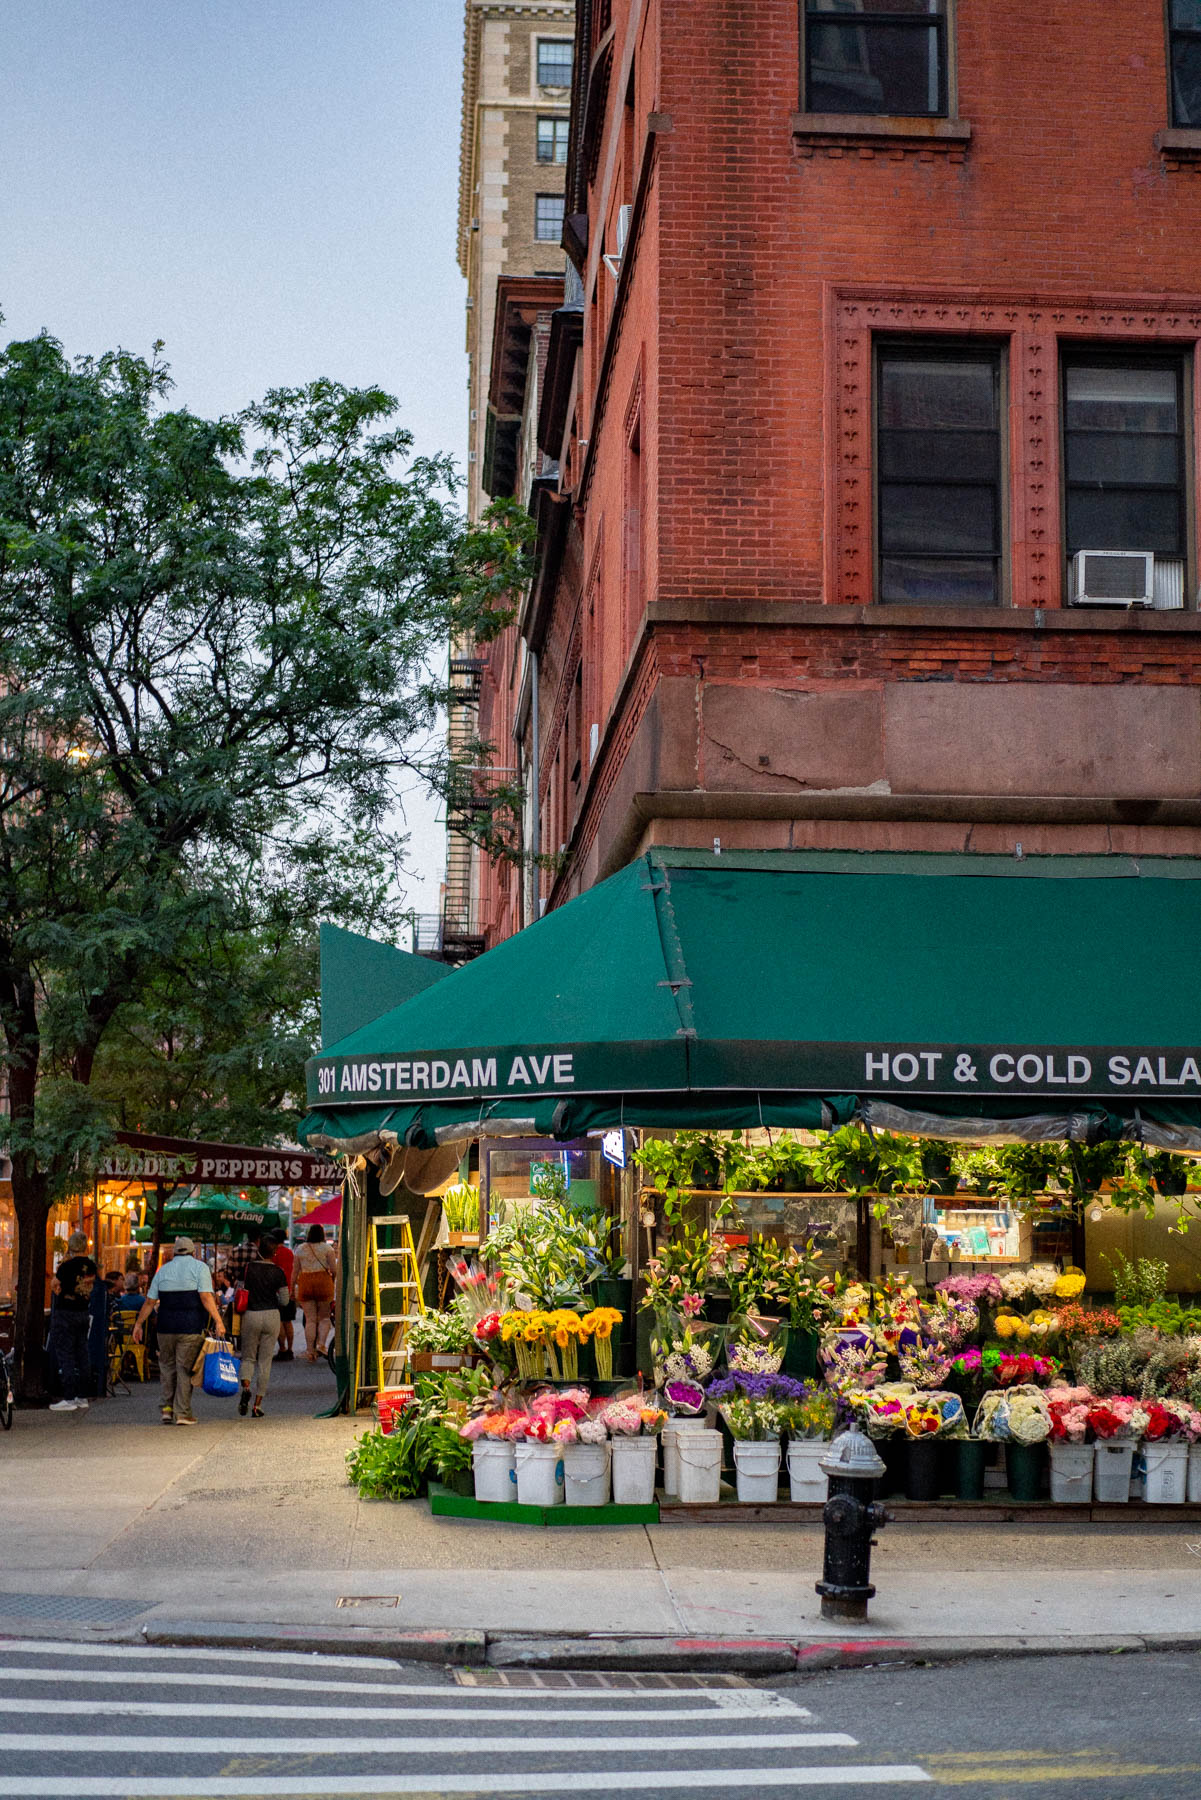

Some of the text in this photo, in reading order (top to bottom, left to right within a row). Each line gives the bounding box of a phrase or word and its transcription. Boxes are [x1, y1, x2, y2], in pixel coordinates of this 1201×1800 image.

[318, 1054, 575, 1094] 301 AMSTERDAM AVE
[865, 1052, 1201, 1085] HOT & COLD SALA
[201, 1159, 303, 1180] PEPPER'S
[310, 1164, 345, 1179] PIZZ
[234, 1210, 265, 1224] Chang
